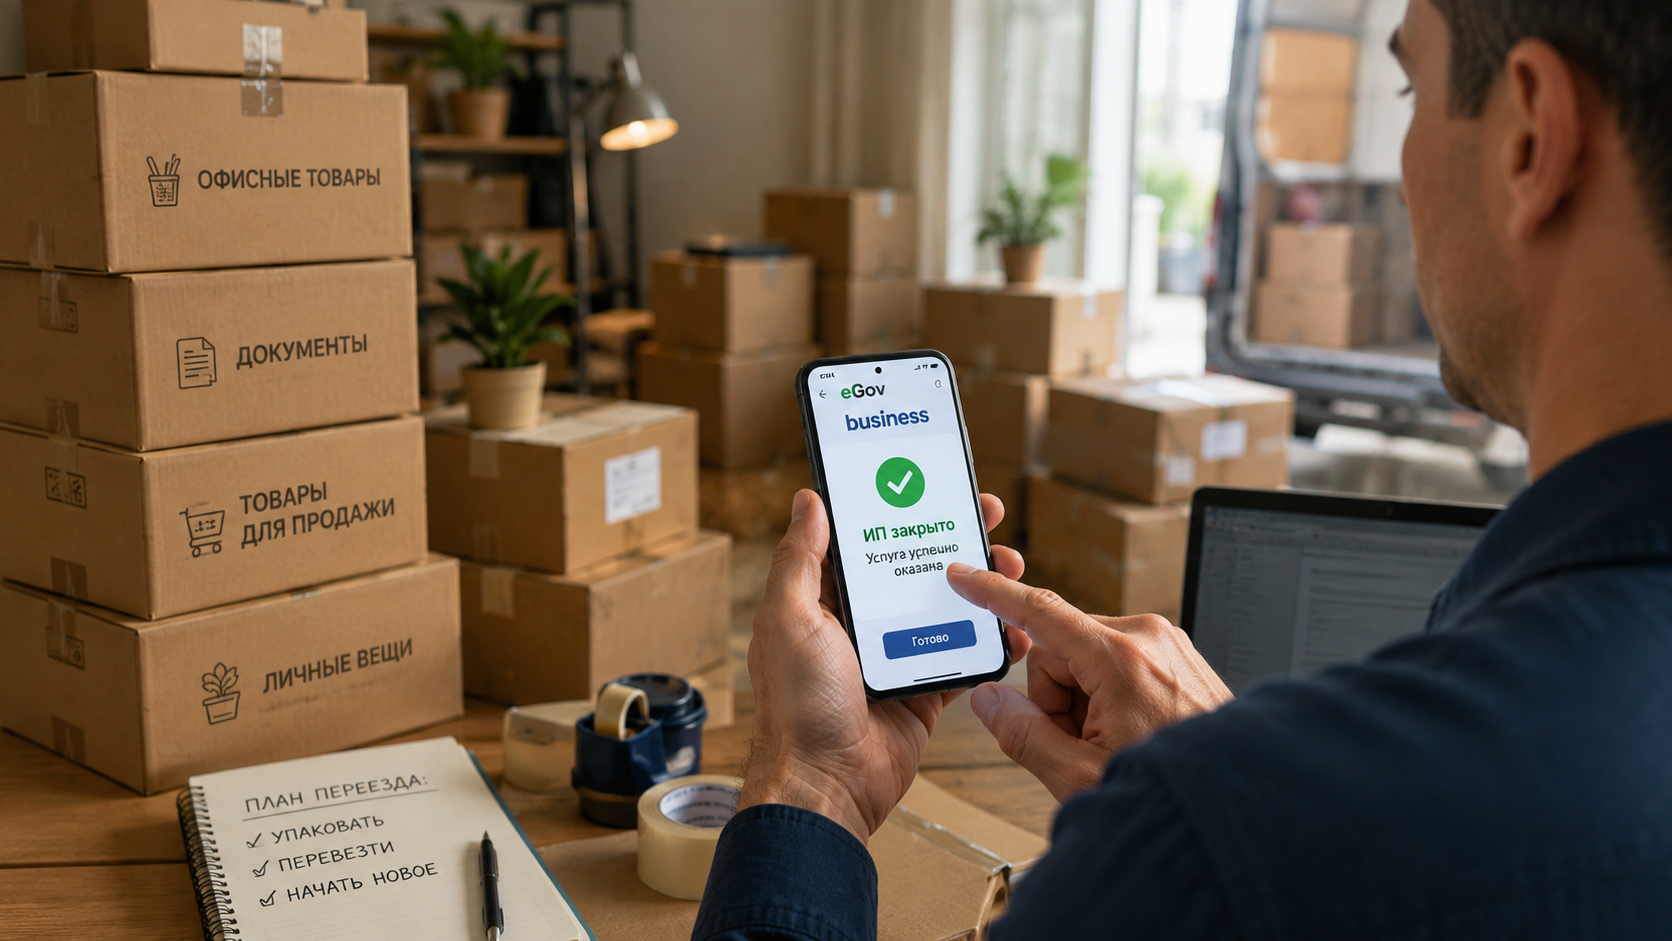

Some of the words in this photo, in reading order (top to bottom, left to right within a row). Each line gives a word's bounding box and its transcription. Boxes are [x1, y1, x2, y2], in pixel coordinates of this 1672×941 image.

[198, 169, 301, 190] ОФИСНЫЕ
[306, 168, 381, 188] ТОВАРЫ
[236, 334, 368, 370] ДОКУМЕНТЫ
[841, 383, 886, 400] eGov
[845, 410, 930, 432] business
[239, 481, 327, 515] ТОВАРЫ
[241, 518, 285, 549] ДЛЯ
[292, 498, 395, 535] ПРОДАЖИ
[863, 526, 887, 543] ИП
[891, 520, 955, 539] закрыто
[894, 561, 944, 577] оказана
[911, 633, 950, 647] Готово
[263, 653, 352, 694] ЛИЧНЫЕ
[357, 638, 413, 669] ВЕЩИ
[245, 791, 303, 812] ПЛАН
[315, 774, 428, 801] ПЕРЕЕЗДА:
[271, 816, 384, 844] УПАКОВАТЬ
[278, 841, 395, 872] ПЕРЕВЕЗТИ
[287, 878, 363, 902] НАЧАТЬ
[371, 862, 438, 886] НОВОЕ
